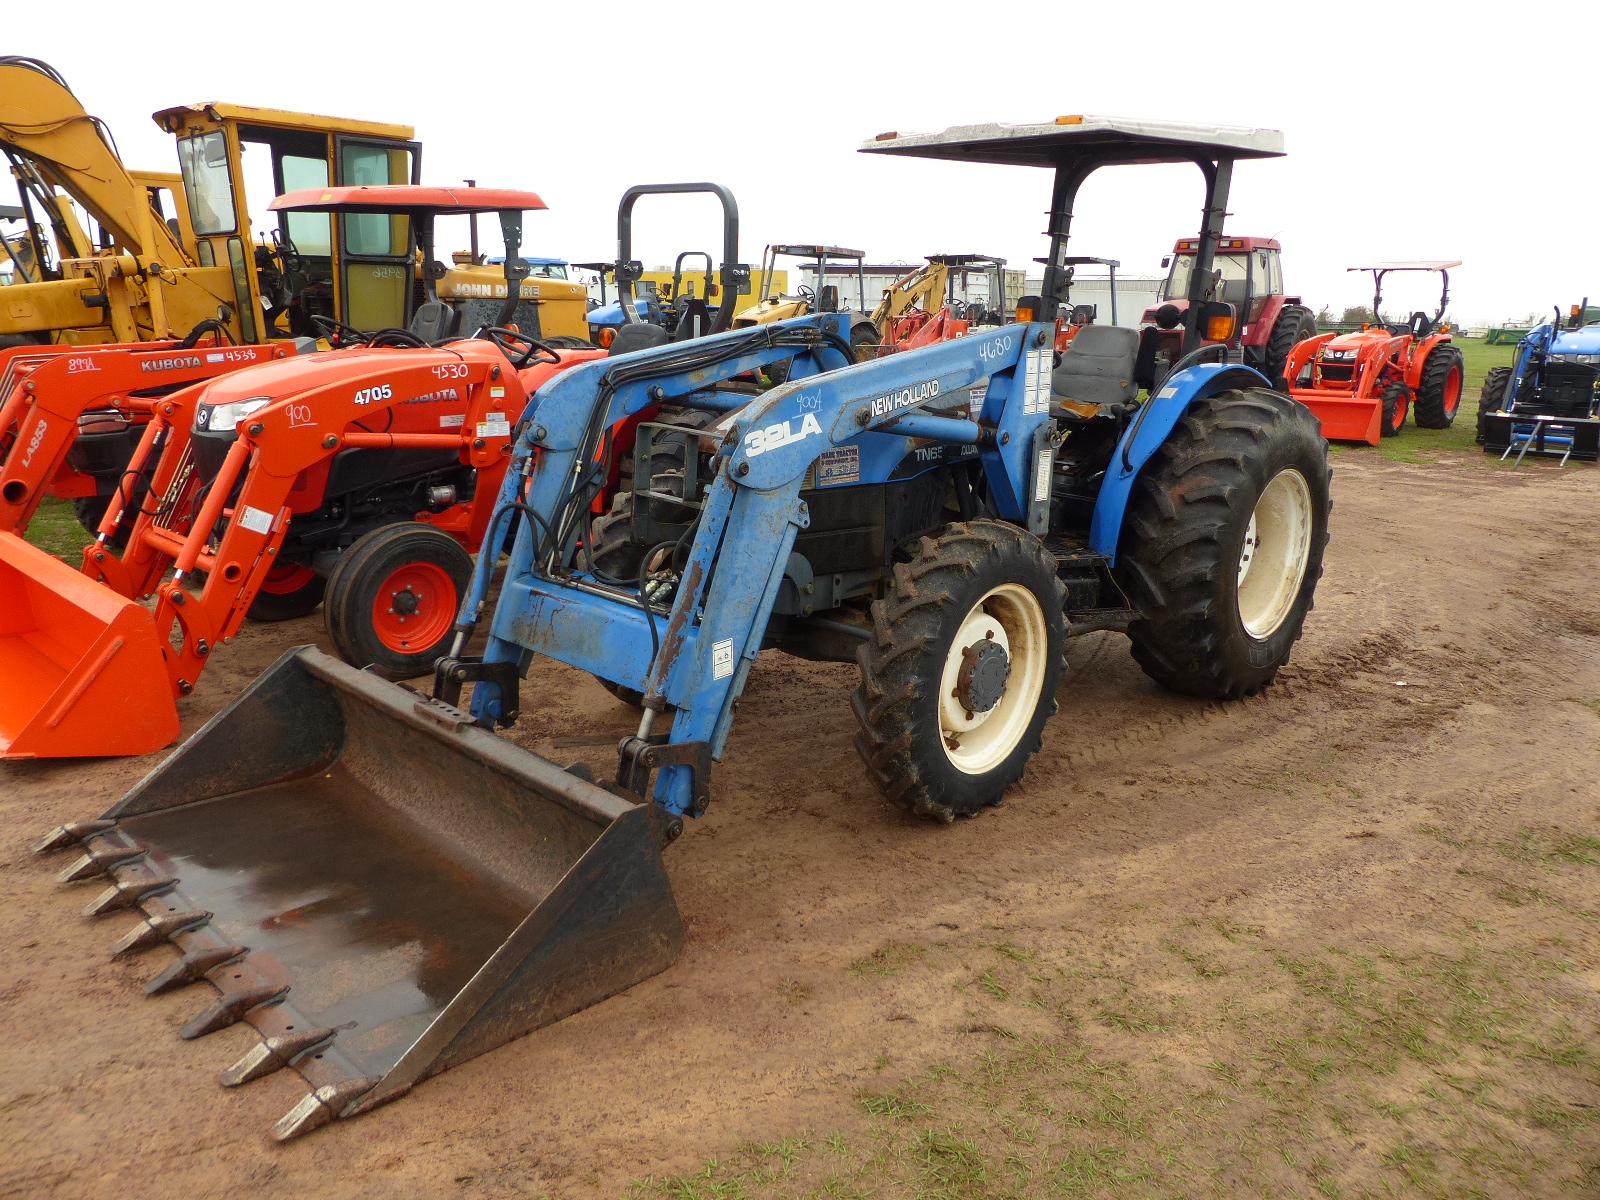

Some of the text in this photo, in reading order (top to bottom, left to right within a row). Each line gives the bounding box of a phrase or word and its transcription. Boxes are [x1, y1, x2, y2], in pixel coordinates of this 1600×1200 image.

[453, 284, 539, 297] JOHN DRE
[226, 349, 257, 361] 4538
[980, 336, 1011, 362] 4680
[141, 356, 202, 373] KUBOTA
[432, 363, 468, 379] 4530
[354, 384, 392, 405] 4705
[404, 388, 460, 404] BOTA
[871, 394, 893, 418] NEW
[894, 379, 940, 410] HOLLAND
[286, 404, 311, 425] 900
[22, 419, 48, 468] LA853
[745, 413, 823, 458] 32LA
